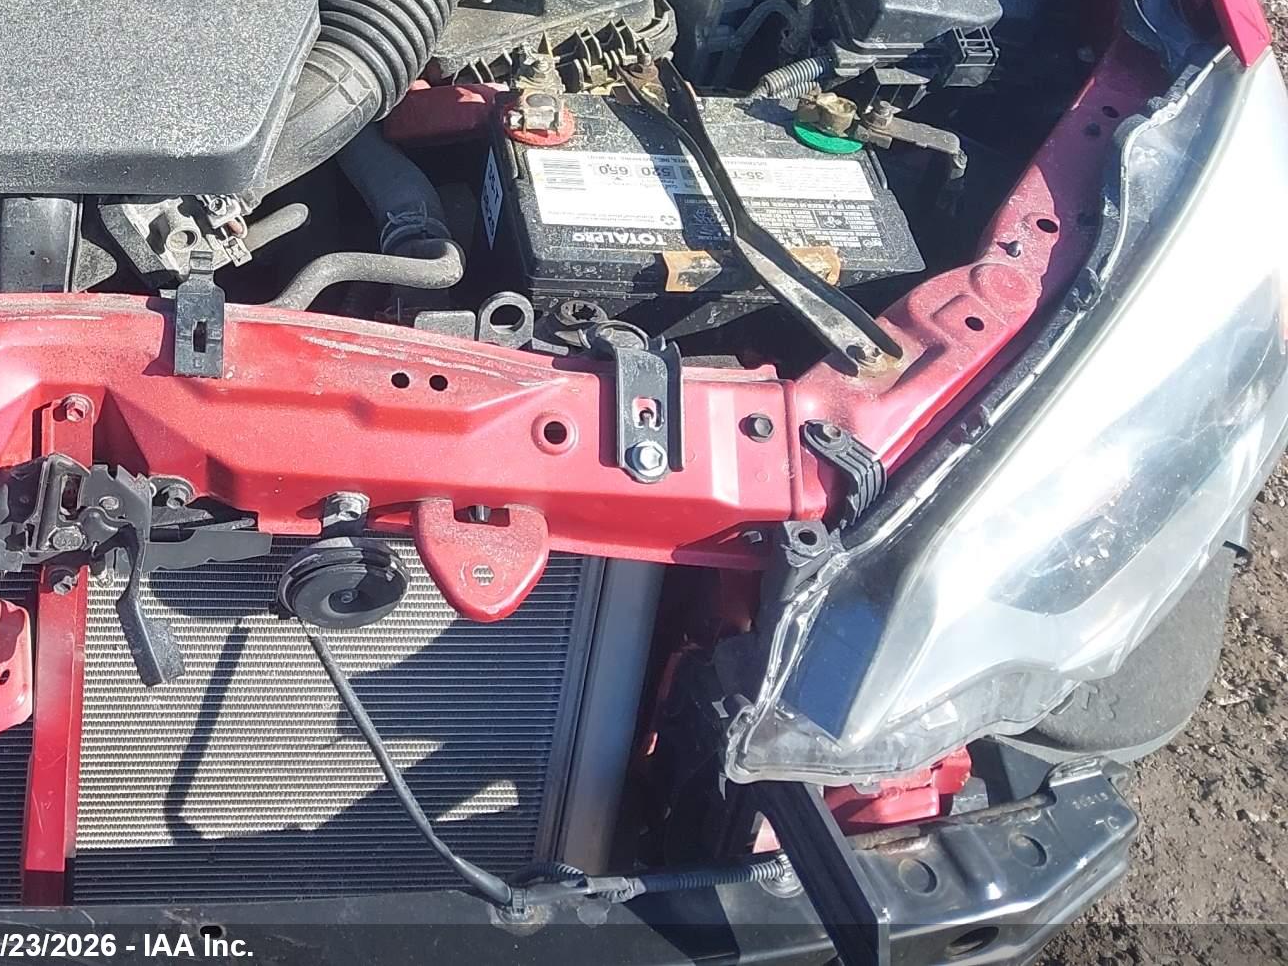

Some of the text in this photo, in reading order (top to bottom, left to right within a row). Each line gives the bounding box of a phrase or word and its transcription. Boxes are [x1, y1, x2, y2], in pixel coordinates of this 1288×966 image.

[598, 165, 629, 176] 650
[641, 166, 673, 177] 520
[733, 170, 765, 181] 35-T
[571, 231, 668, 246] TOTALPRO
